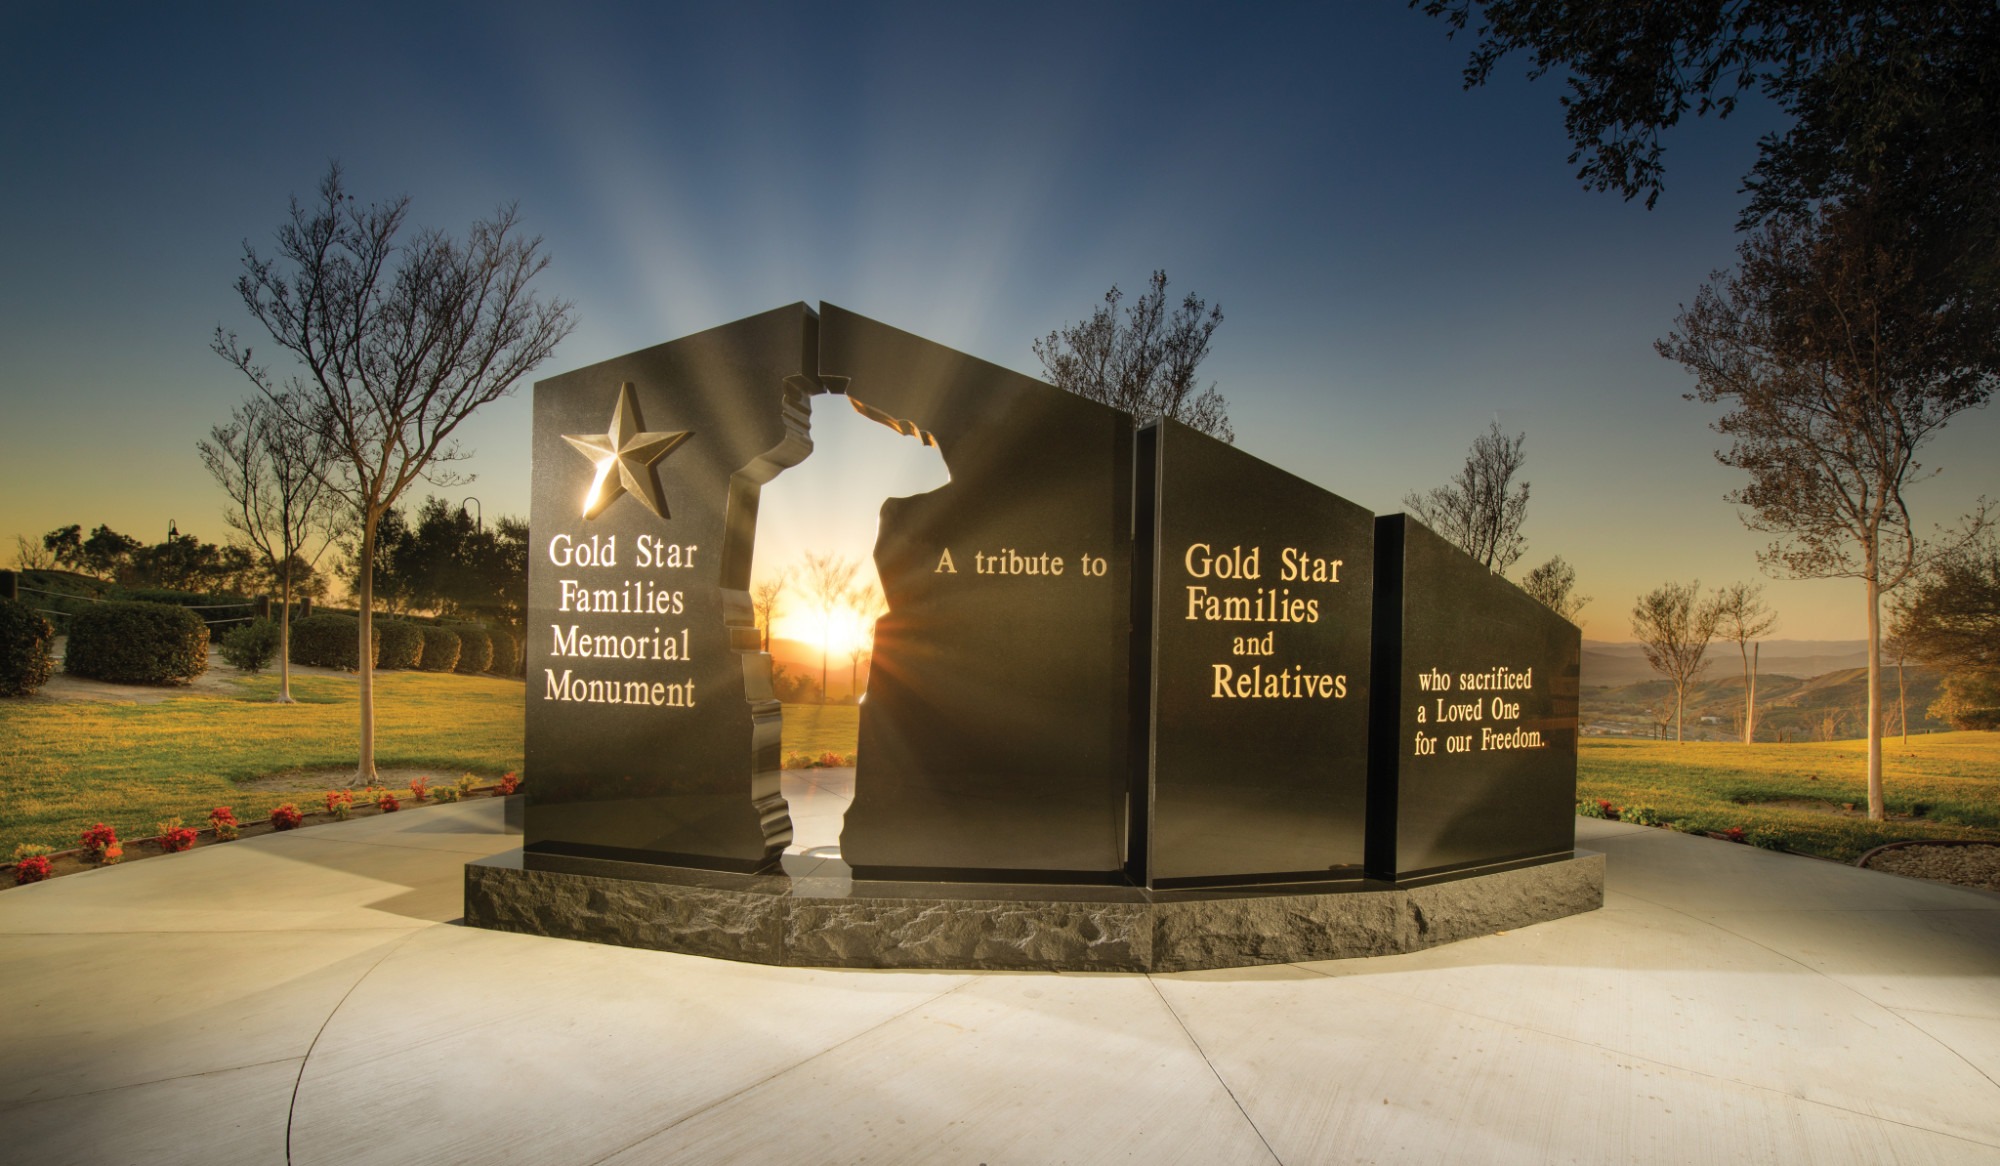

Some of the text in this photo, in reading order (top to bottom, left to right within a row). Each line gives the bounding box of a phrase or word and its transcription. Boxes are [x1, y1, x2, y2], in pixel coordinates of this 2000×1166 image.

[549, 534, 698, 568] Gold Star
[935, 547, 1107, 577] A tribute to
[1185, 543, 1343, 583] Gold Star
[558, 579, 684, 615] Families
[1185, 586, 1320, 623] Families
[550, 624, 691, 661] Memorial
[1232, 631, 1275, 656] and
[543, 669, 696, 708] Monument
[1211, 664, 1347, 699] Relatives
[1419, 667, 1533, 691] who sacrificed
[1417, 696, 1520, 723] a Loved One
[1414, 726, 1545, 756] for our Freedom.
